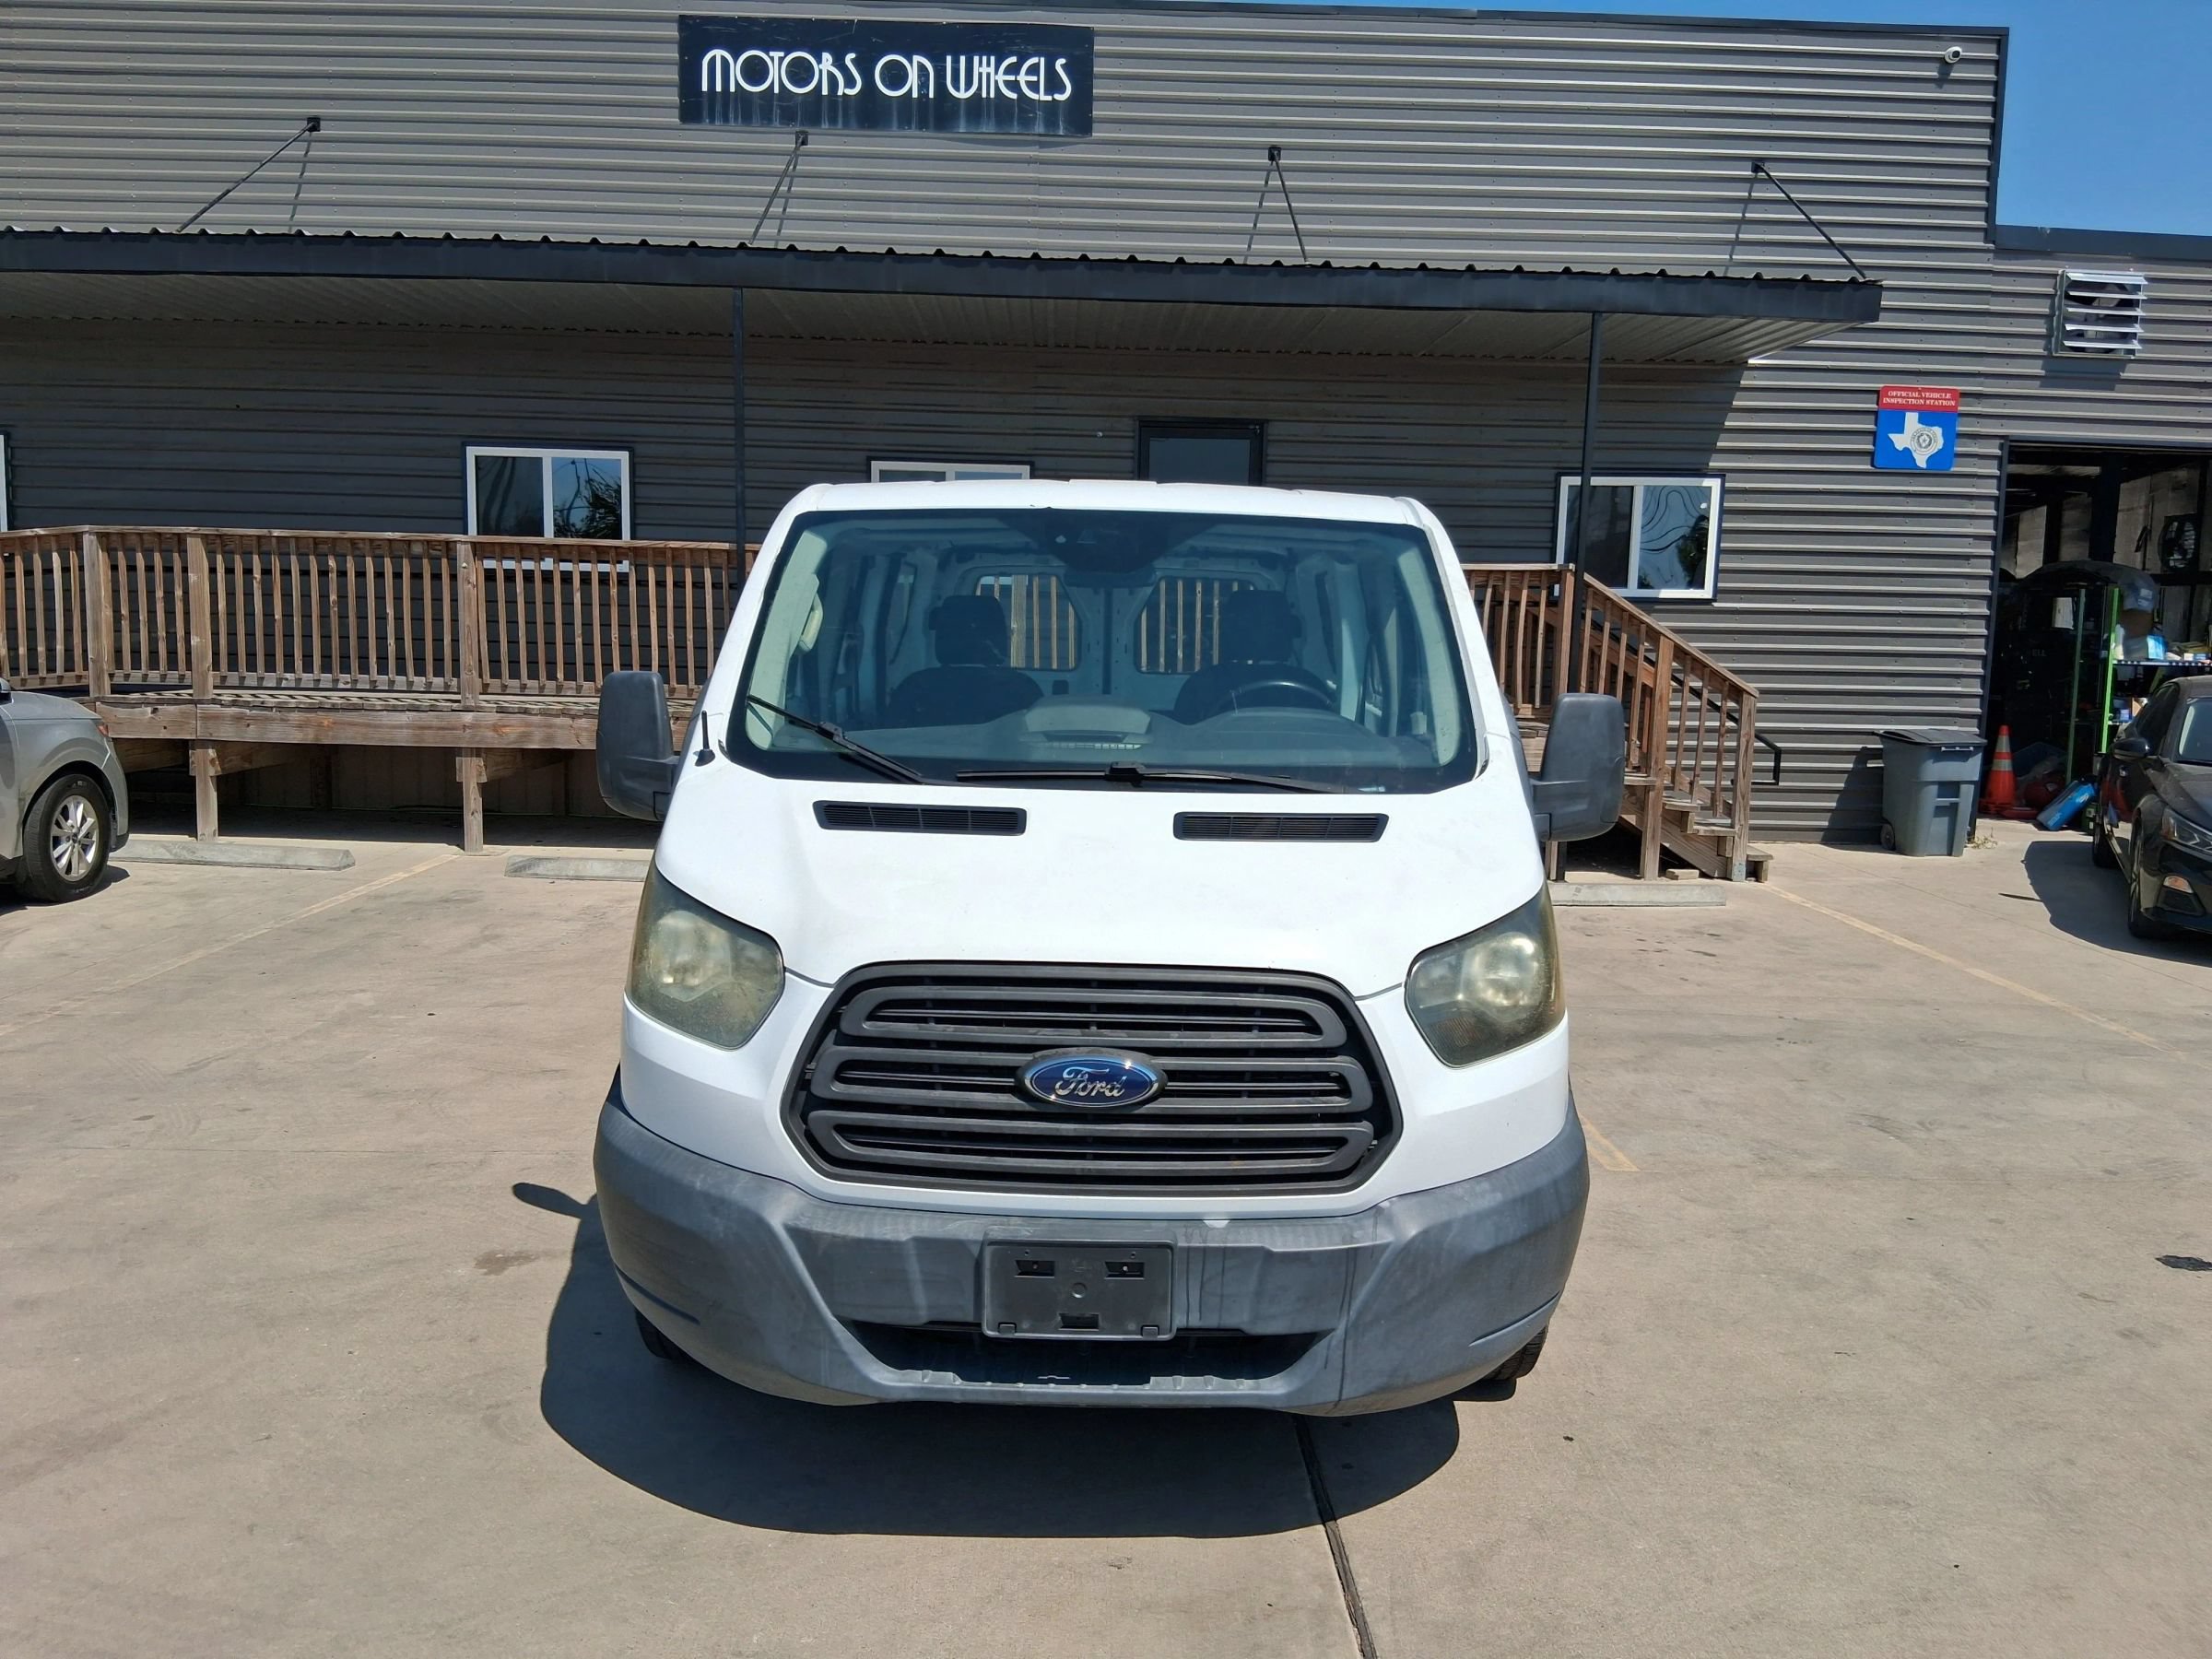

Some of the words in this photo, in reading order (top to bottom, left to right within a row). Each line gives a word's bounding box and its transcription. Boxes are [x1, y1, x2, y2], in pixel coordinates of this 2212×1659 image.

[701, 48, 863, 97] MOTORS
[874, 53, 935, 100] ON
[946, 53, 1073, 101] WHEELS
[1054, 1066, 1127, 1097] Ford
